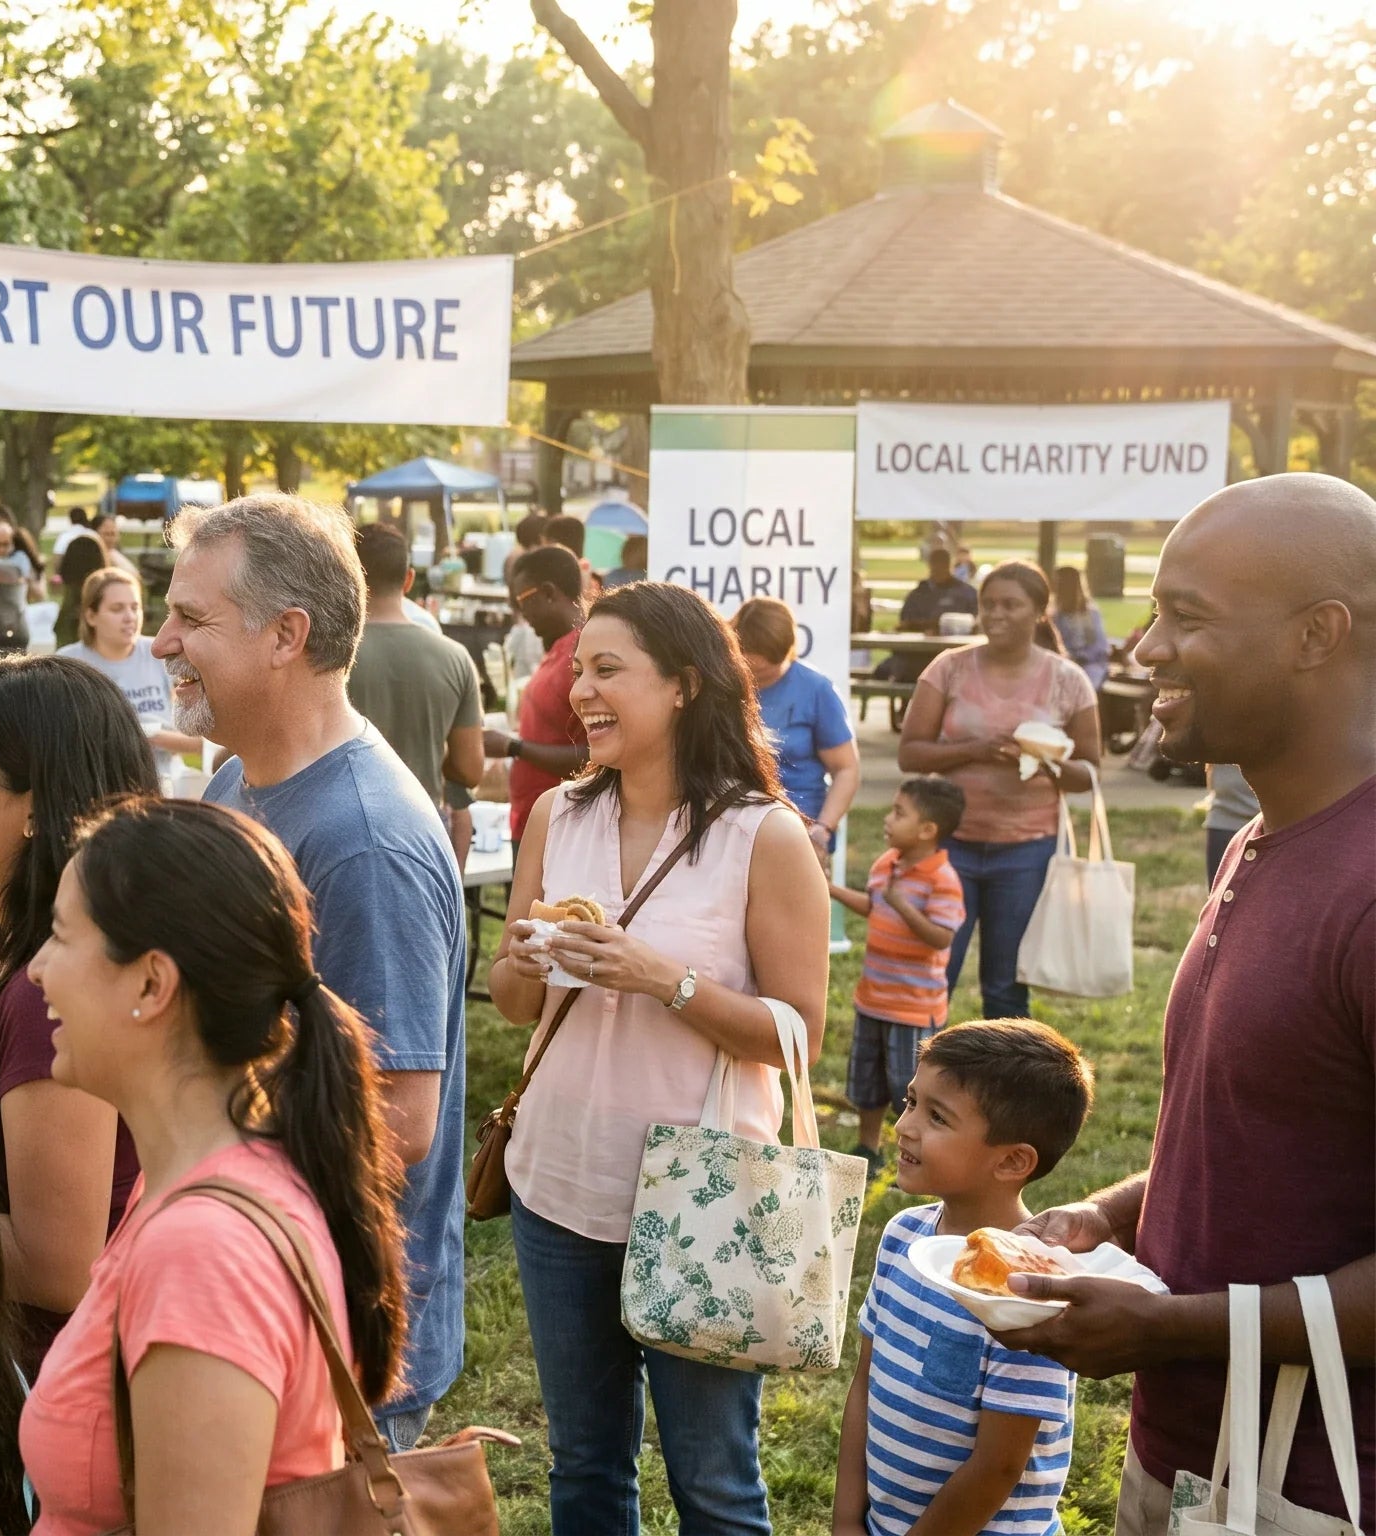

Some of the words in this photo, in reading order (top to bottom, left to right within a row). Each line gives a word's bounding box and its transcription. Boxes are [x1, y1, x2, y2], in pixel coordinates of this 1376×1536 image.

[71, 284, 209, 355] OUR
[228, 293, 461, 361] FUTURE
[875, 442, 970, 474] LOCAL
[981, 442, 1112, 474] CHARITY
[1124, 443, 1209, 474] FUND
[688, 507, 815, 547] LOCAL
